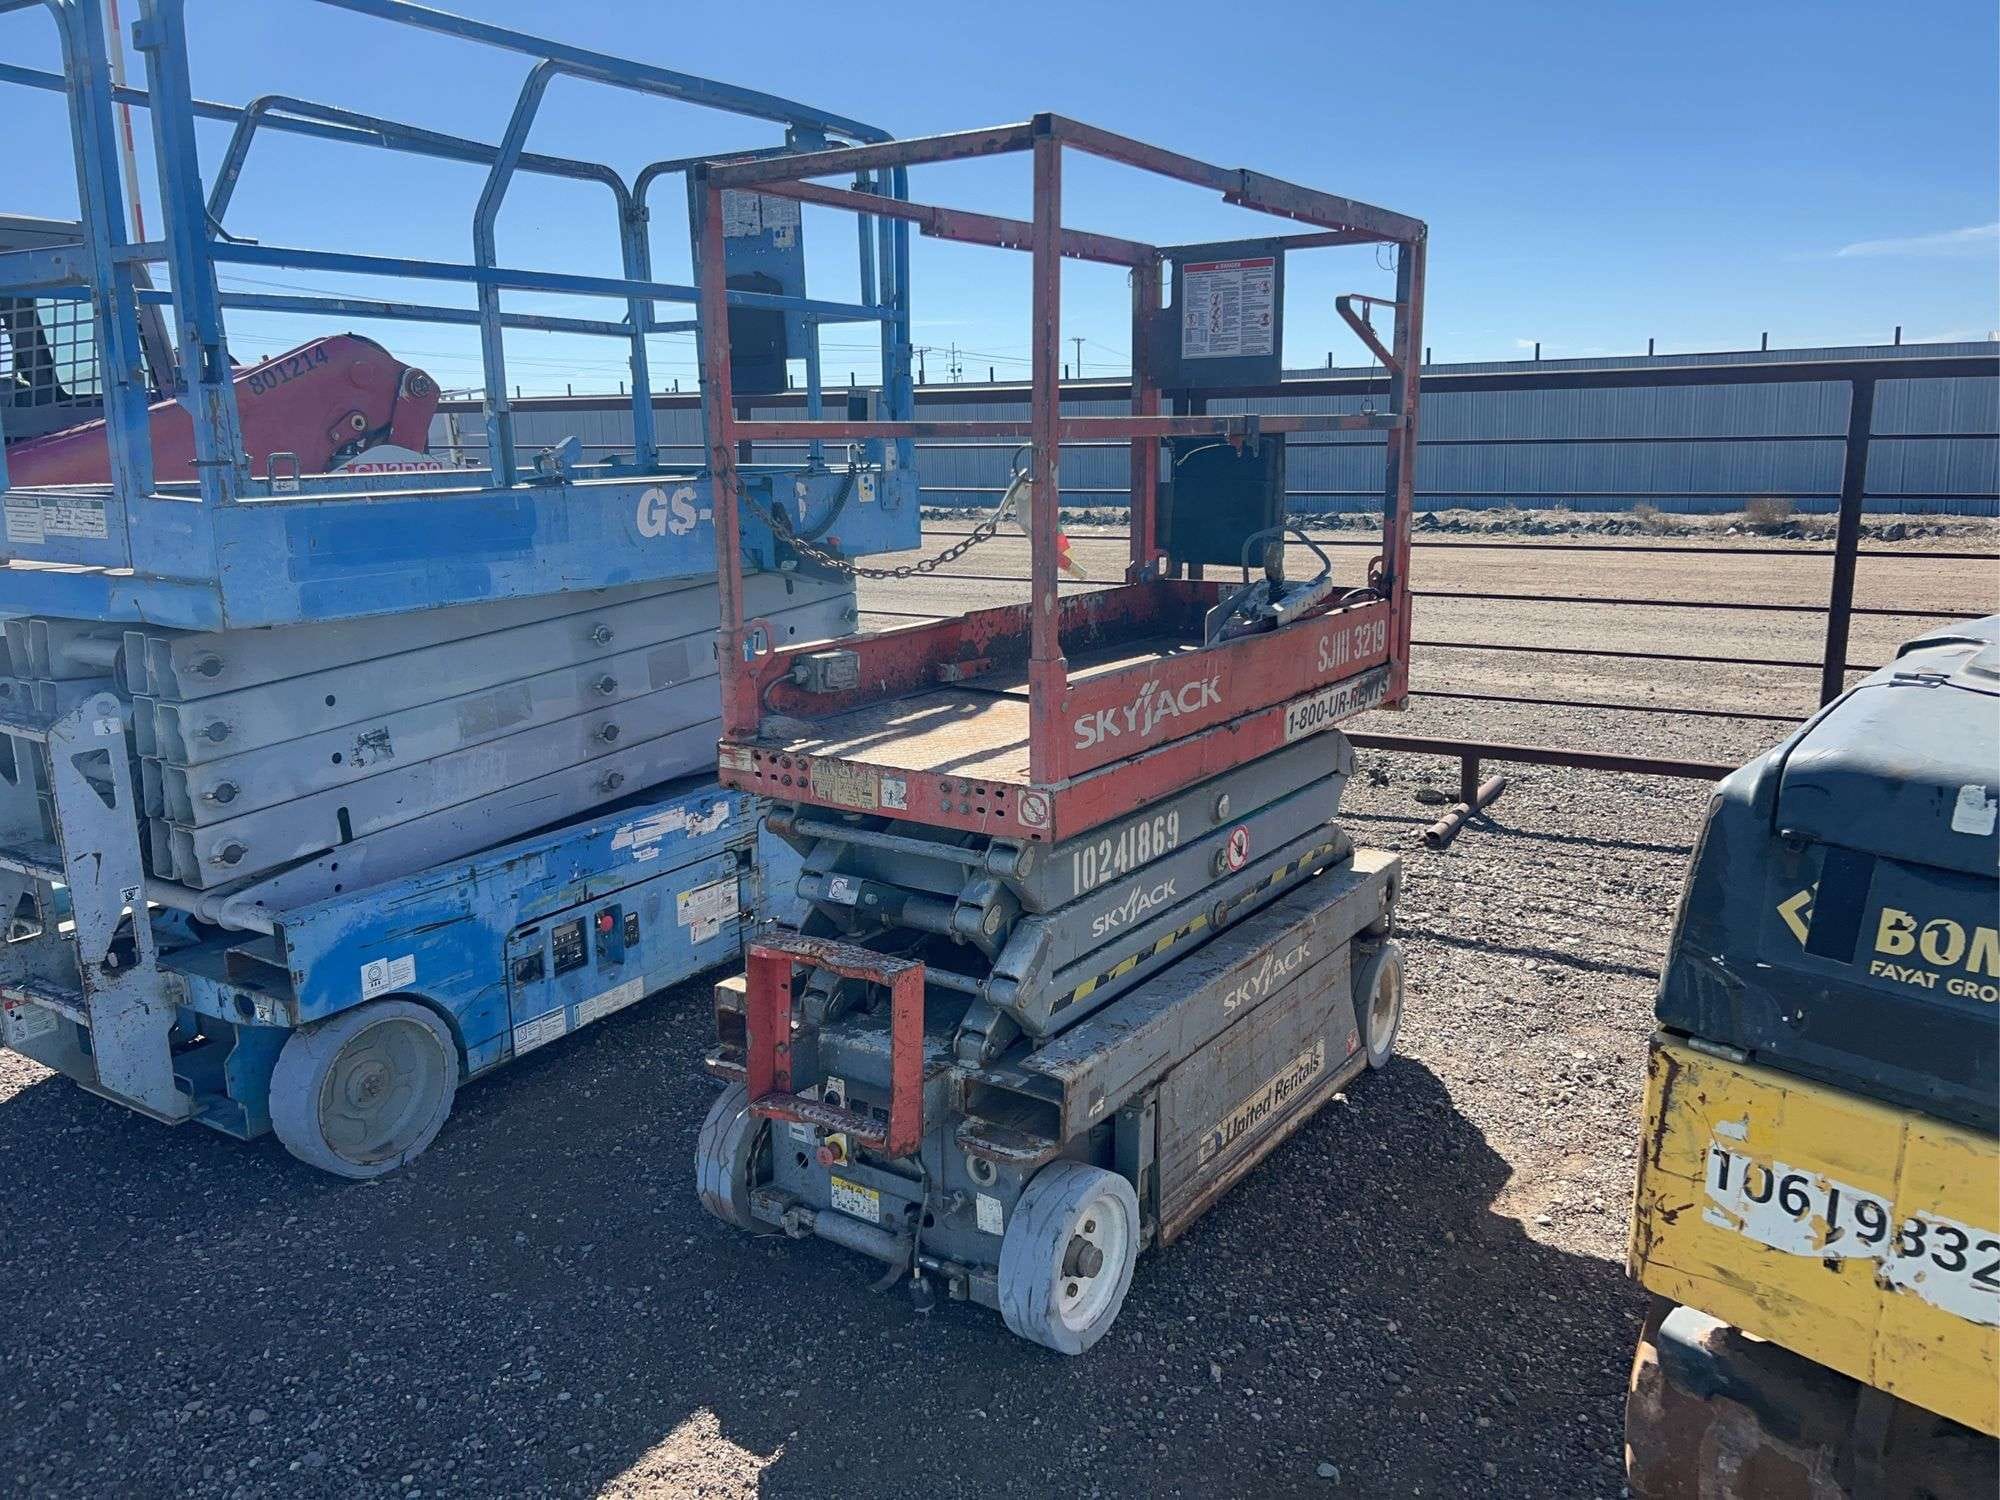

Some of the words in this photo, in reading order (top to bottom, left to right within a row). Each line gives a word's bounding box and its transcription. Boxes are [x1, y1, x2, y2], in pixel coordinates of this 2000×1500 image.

[249, 344, 329, 395] 801214
[1354, 619, 1386, 660] 3219
[1073, 675, 1223, 750] SKYJACK
[1073, 810, 1180, 896] 10241869
[1092, 877, 1177, 938] SKYJACK
[1223, 941, 1311, 1017] SKYJACK
[1869, 960, 1940, 990] FAYAT
[1225, 1087, 1271, 1145] United
[1274, 1050, 1320, 1105] Rentals
